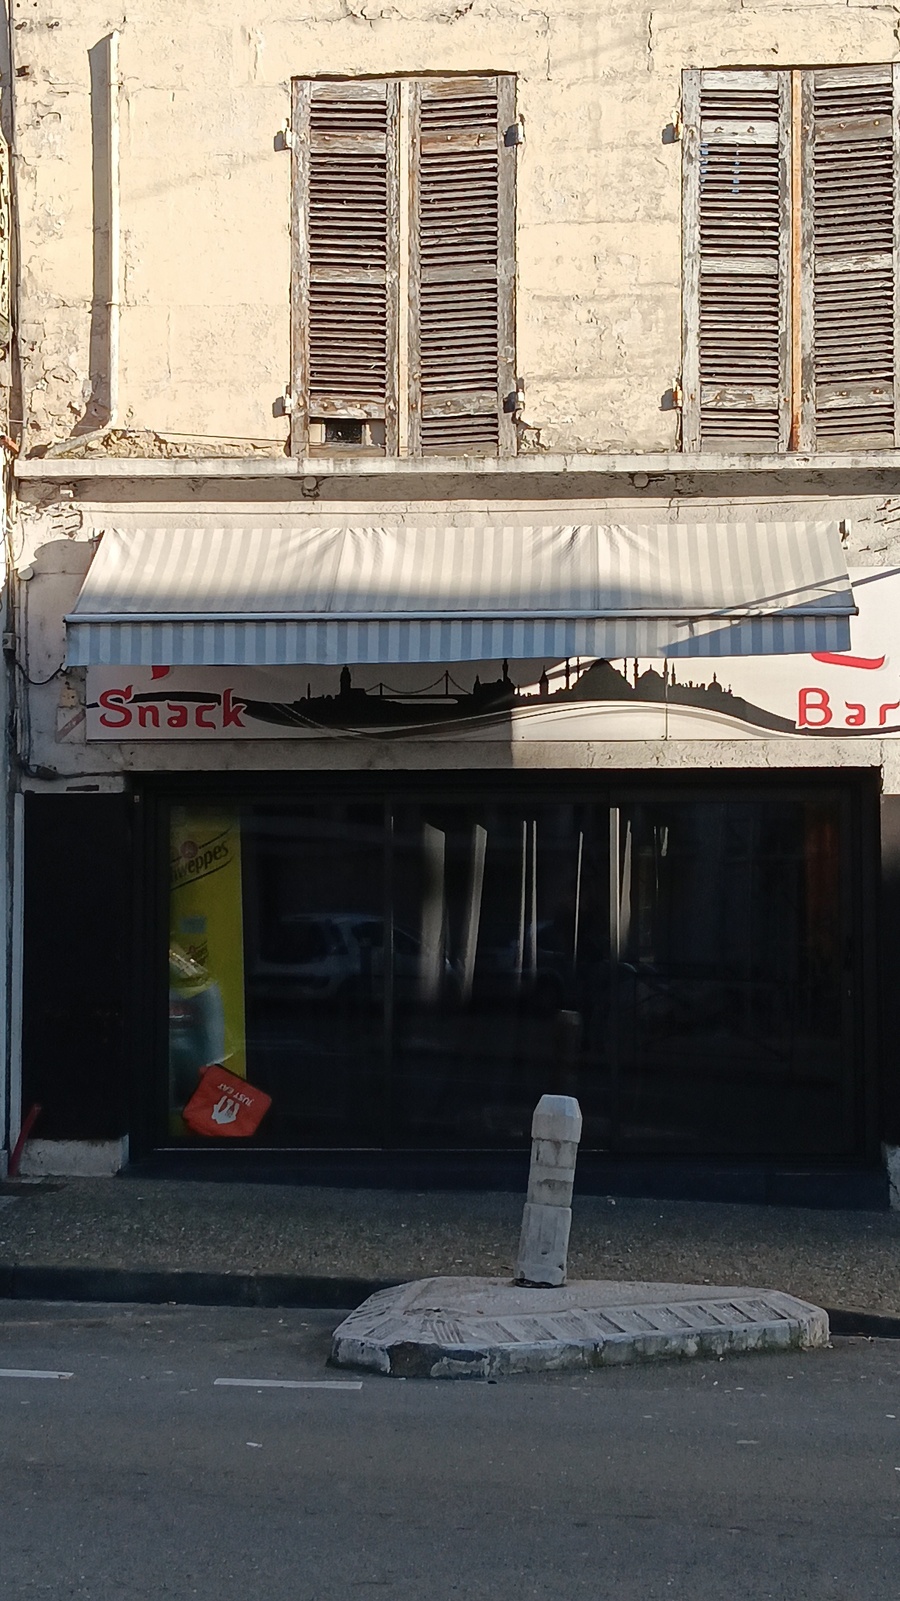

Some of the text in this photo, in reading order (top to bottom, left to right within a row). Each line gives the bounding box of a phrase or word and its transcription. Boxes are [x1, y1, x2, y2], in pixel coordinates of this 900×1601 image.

[100, 685, 246, 729] Snack
[798, 688, 900, 726] Bar
[217, 1083, 254, 1106] JUST EAT
